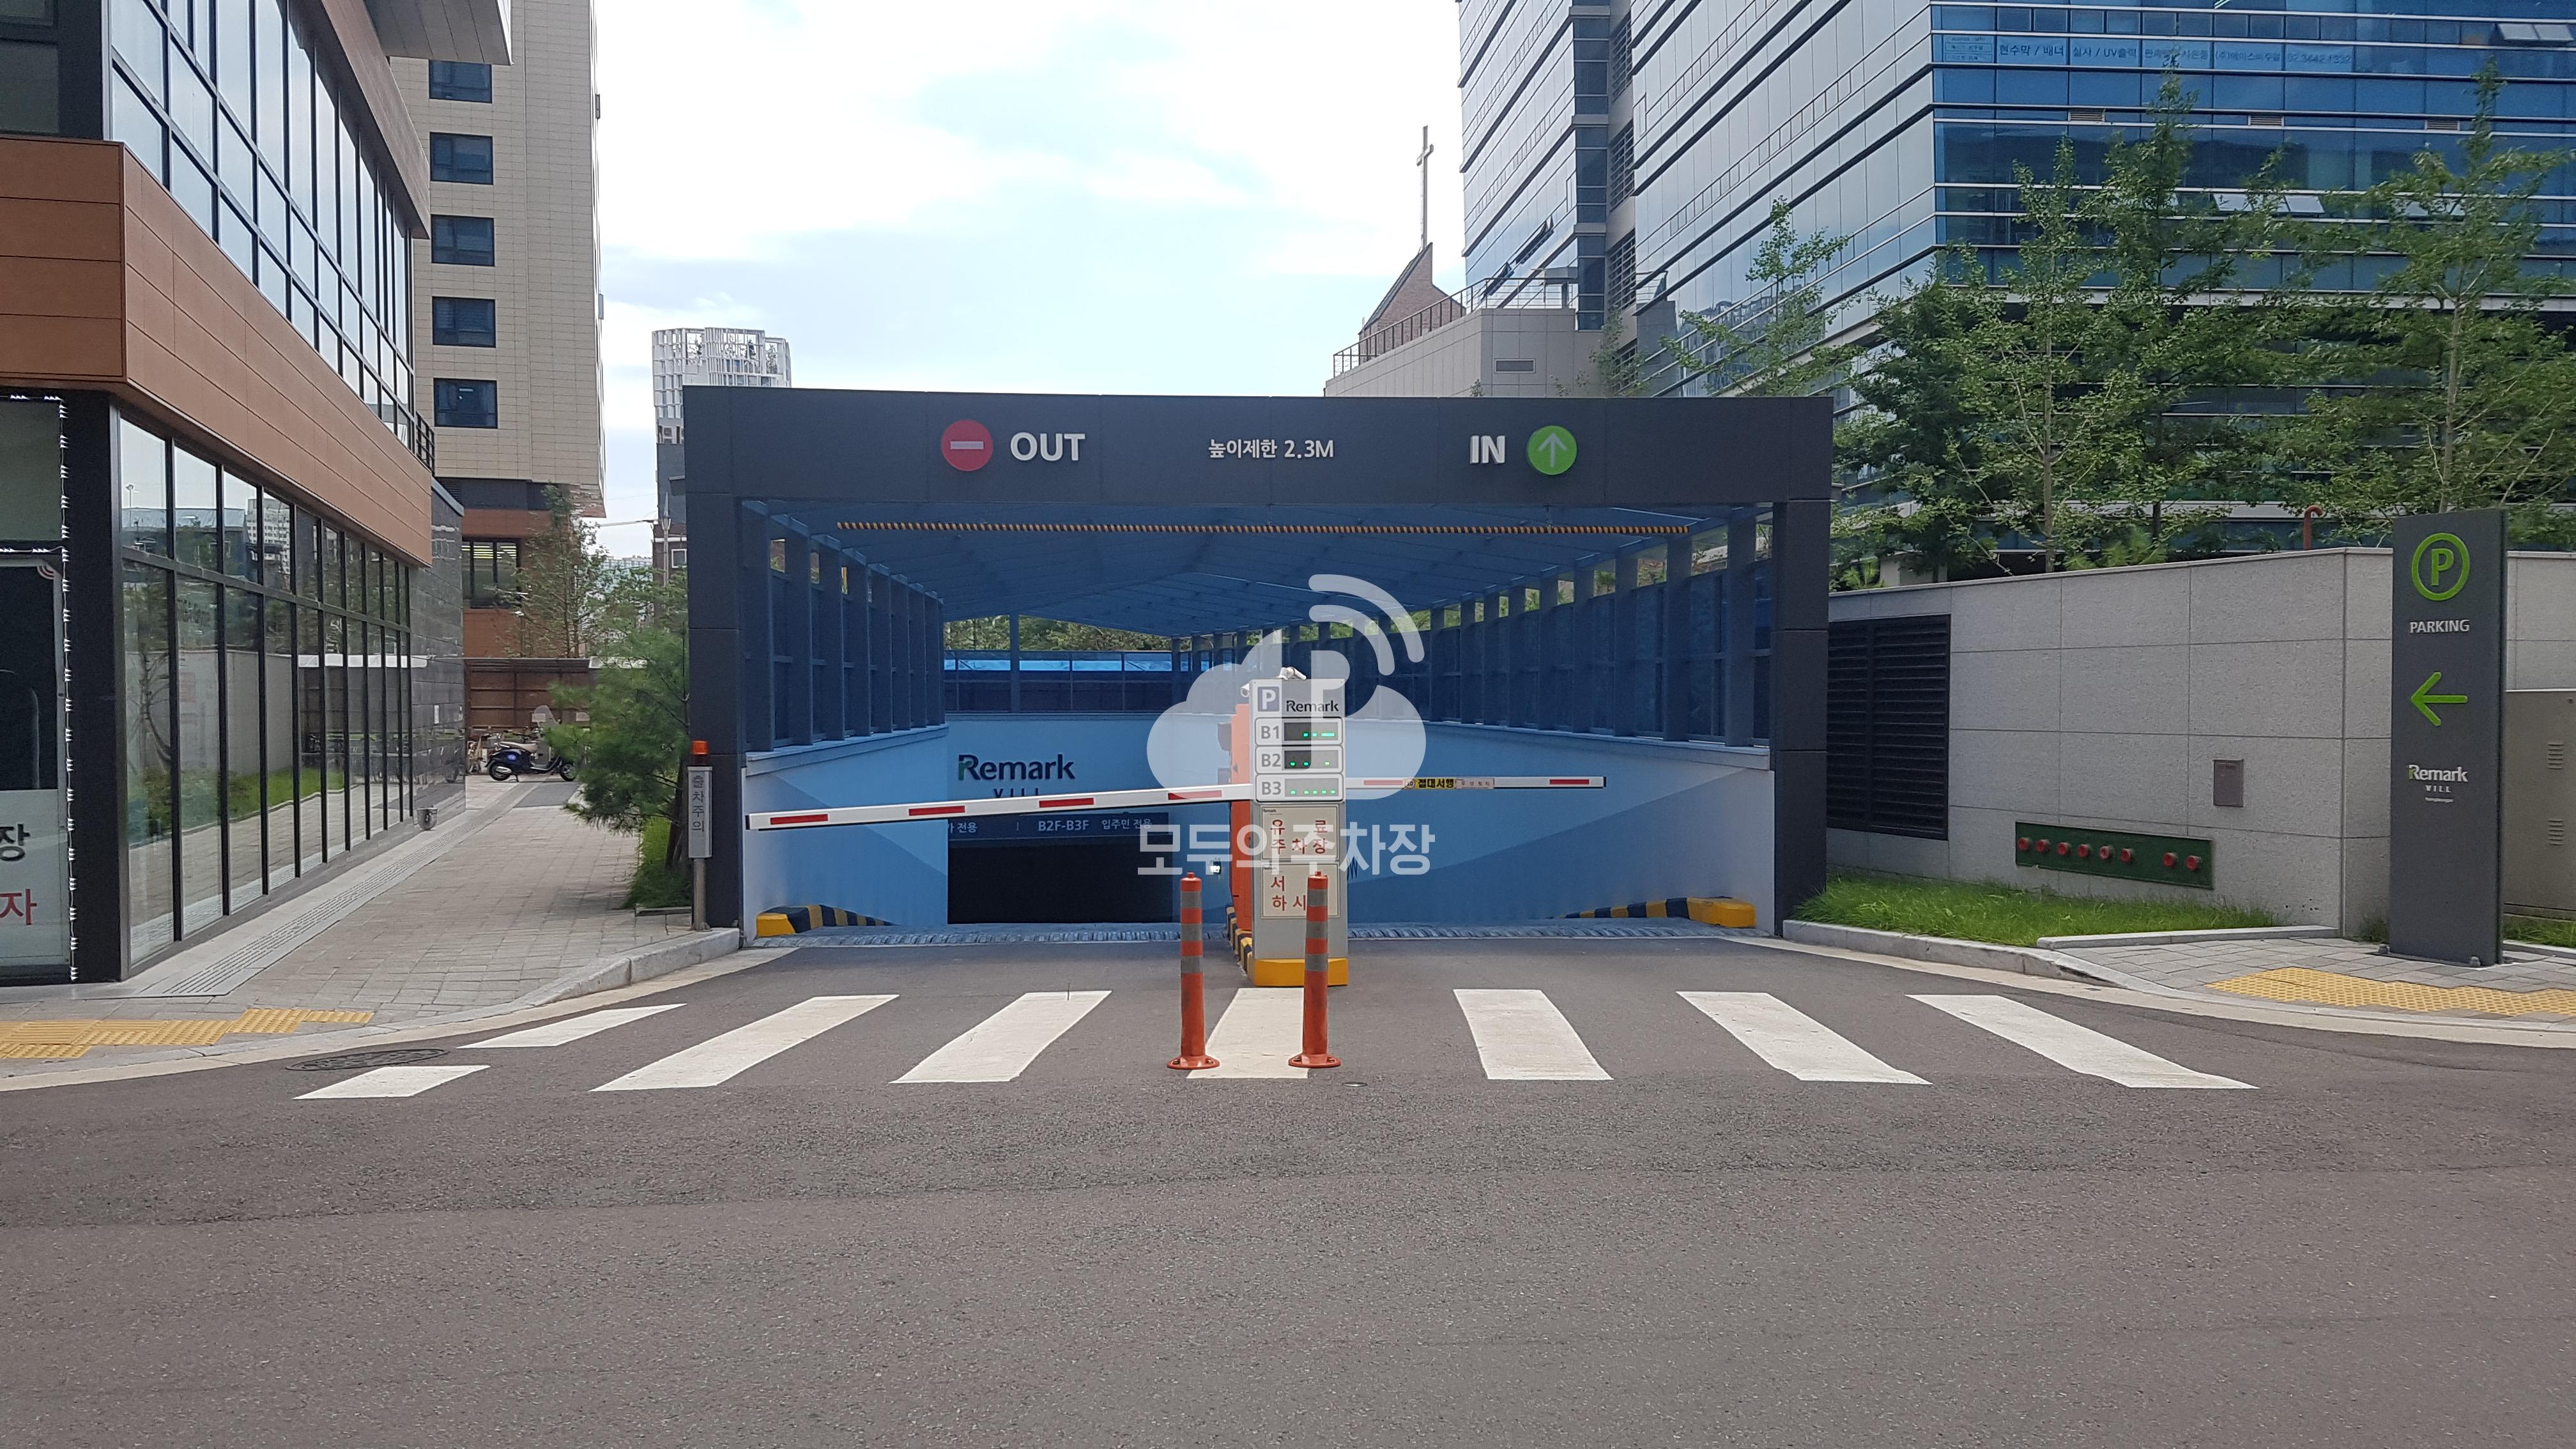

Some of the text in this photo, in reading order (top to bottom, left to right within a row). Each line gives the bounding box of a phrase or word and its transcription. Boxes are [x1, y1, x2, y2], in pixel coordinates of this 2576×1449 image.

[1999, 45, 2030, 57] 현수막
[2044, 46, 2064, 57] 배너
[2074, 47, 2092, 57] 실사
[2104, 48, 2137, 59] UV출력
[1010, 431, 1086, 461] OUT
[1208, 439, 1334, 459] 높이제한 2.3M
[1470, 435, 1505, 464] IN
[2431, 548, 2454, 586] P
[2409, 619, 2470, 634] PARKING
[1262, 689, 1276, 710] P
[1286, 700, 1339, 712] Remark
[1261, 725, 1280, 739] B1
[958, 753, 1076, 781] Remark
[1261, 753, 1282, 767] B2
[2409, 764, 2469, 783] Remark
[1262, 781, 1282, 795] B3
[1418, 778, 1454, 788] 절대서행
[2425, 785, 2451, 793] VILL
[692, 775, 705, 832] 출차주의
[957, 822, 978, 833] 전용
[1038, 820, 1090, 831] B2F-B3F
[1101, 818, 1130, 831] 입주민
[1133, 818, 1153, 831] 전용
[1271, 838, 1329, 855] 주차장
[1270, 875, 1285, 892] 서
[1271, 895, 1306, 912] 하시
